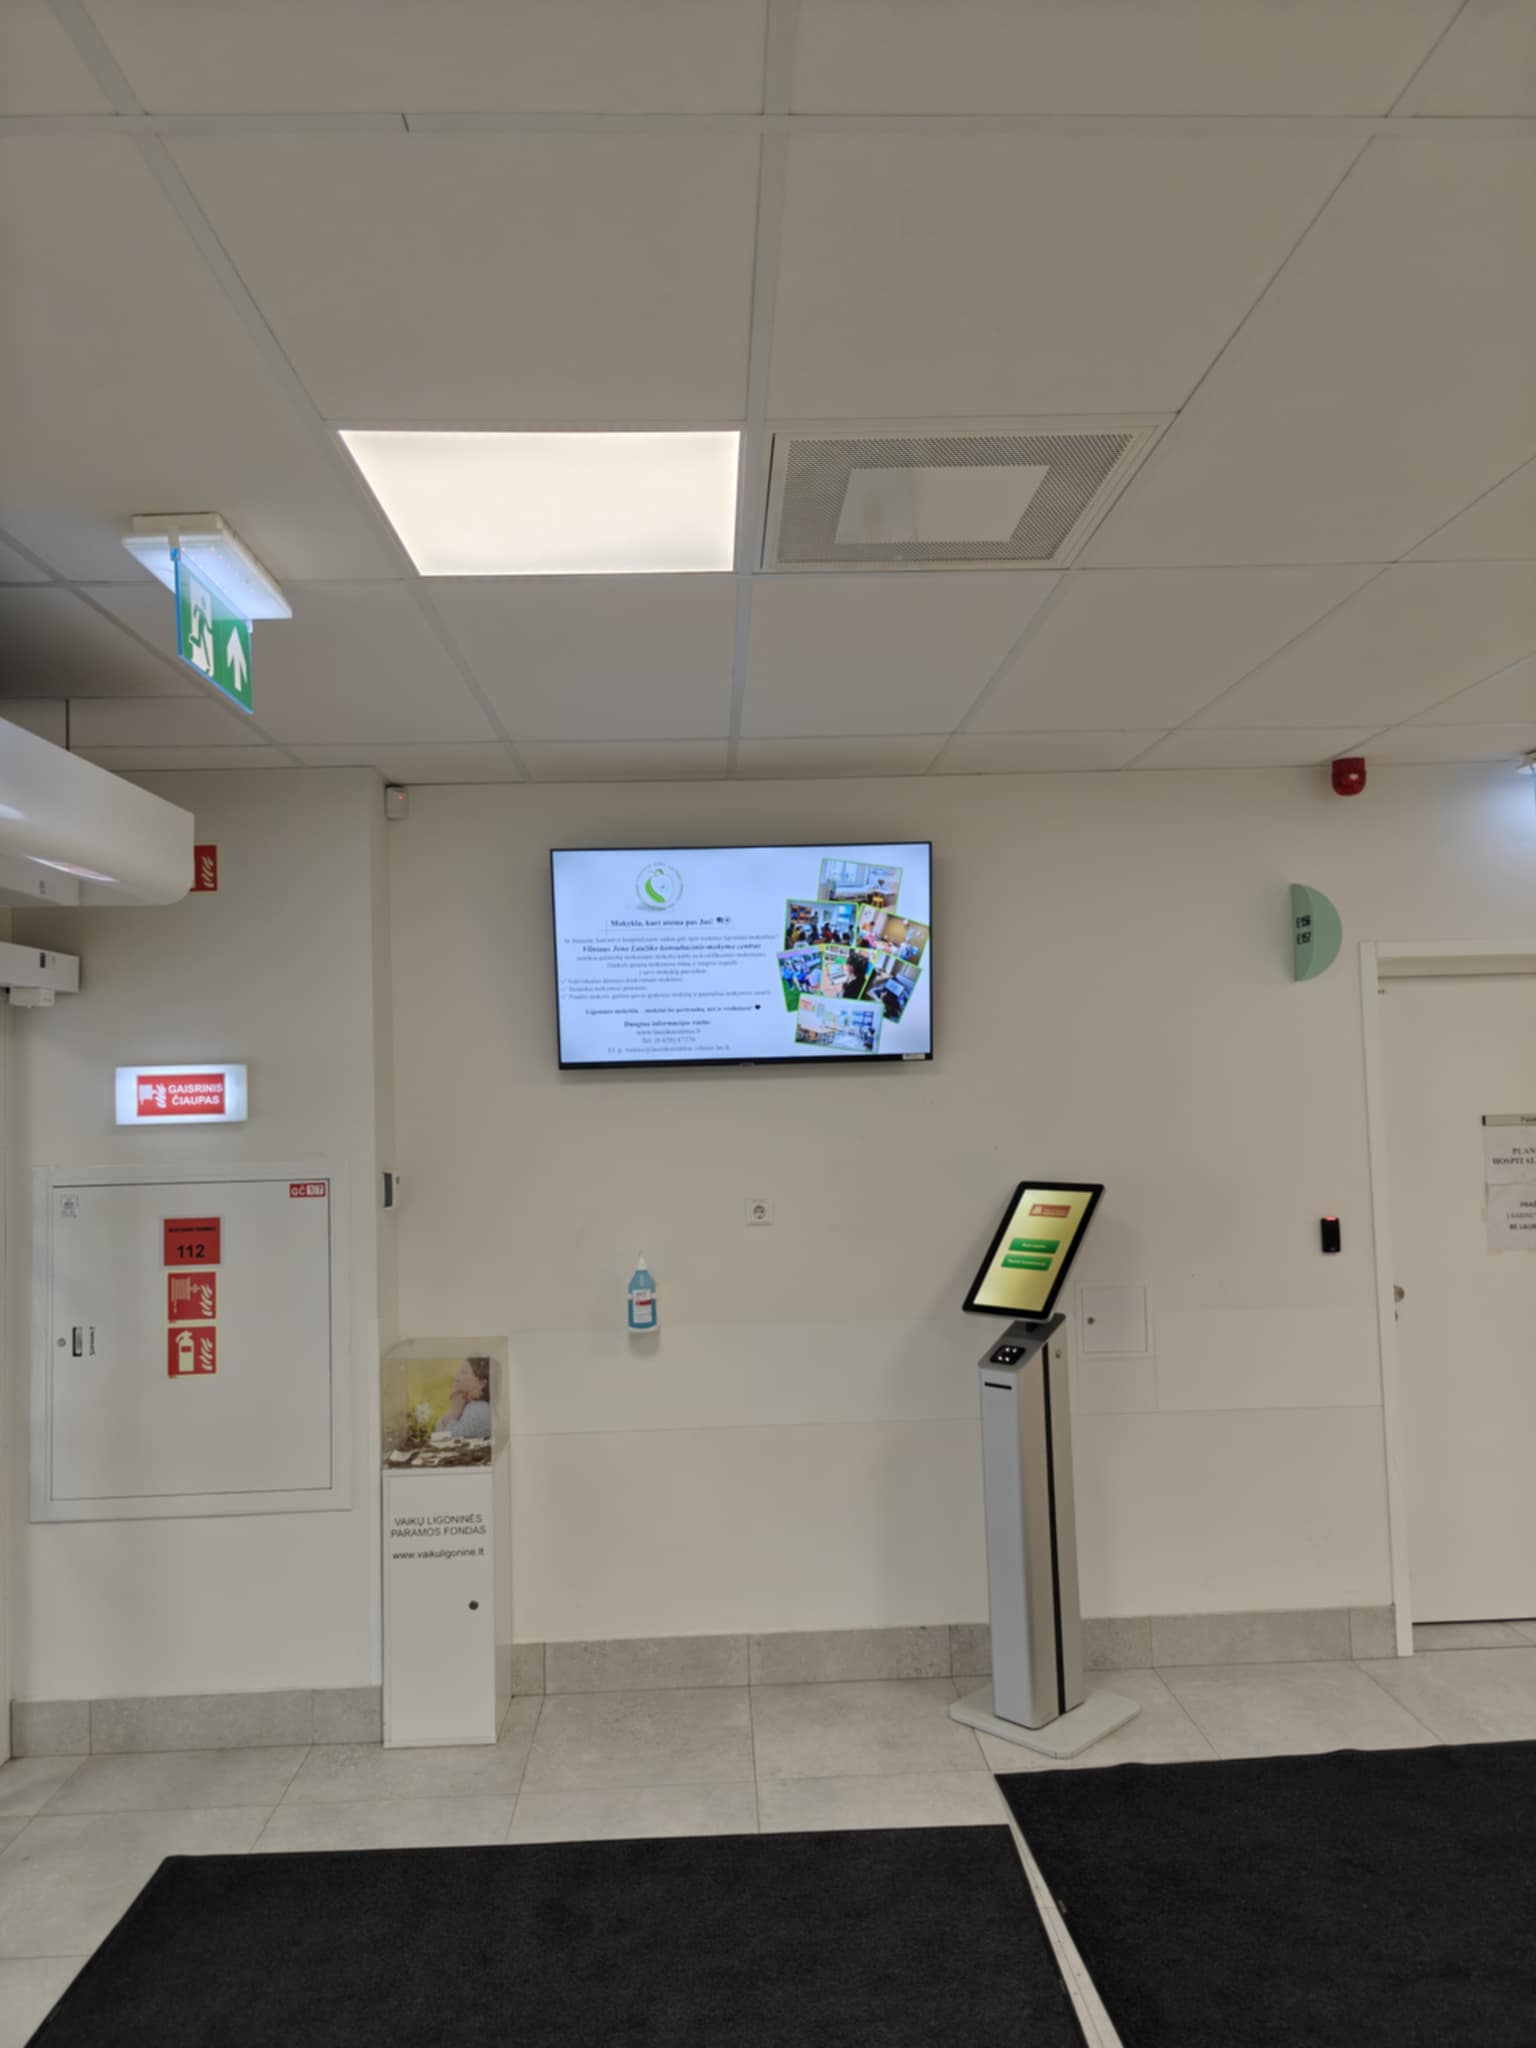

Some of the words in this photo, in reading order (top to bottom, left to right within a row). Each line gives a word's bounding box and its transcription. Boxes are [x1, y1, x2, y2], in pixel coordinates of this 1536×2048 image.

[168, 1083, 223, 1094] GAISRINIS
[171, 1094, 220, 1106] ČIAUPAS
[177, 1243, 206, 1259] 112
[394, 1516, 425, 1527] VAIKŲ
[427, 1513, 482, 1526] LIGONINĖS
[391, 1528, 441, 1537] PARAMOS
[444, 1525, 487, 1536] FONDAS
